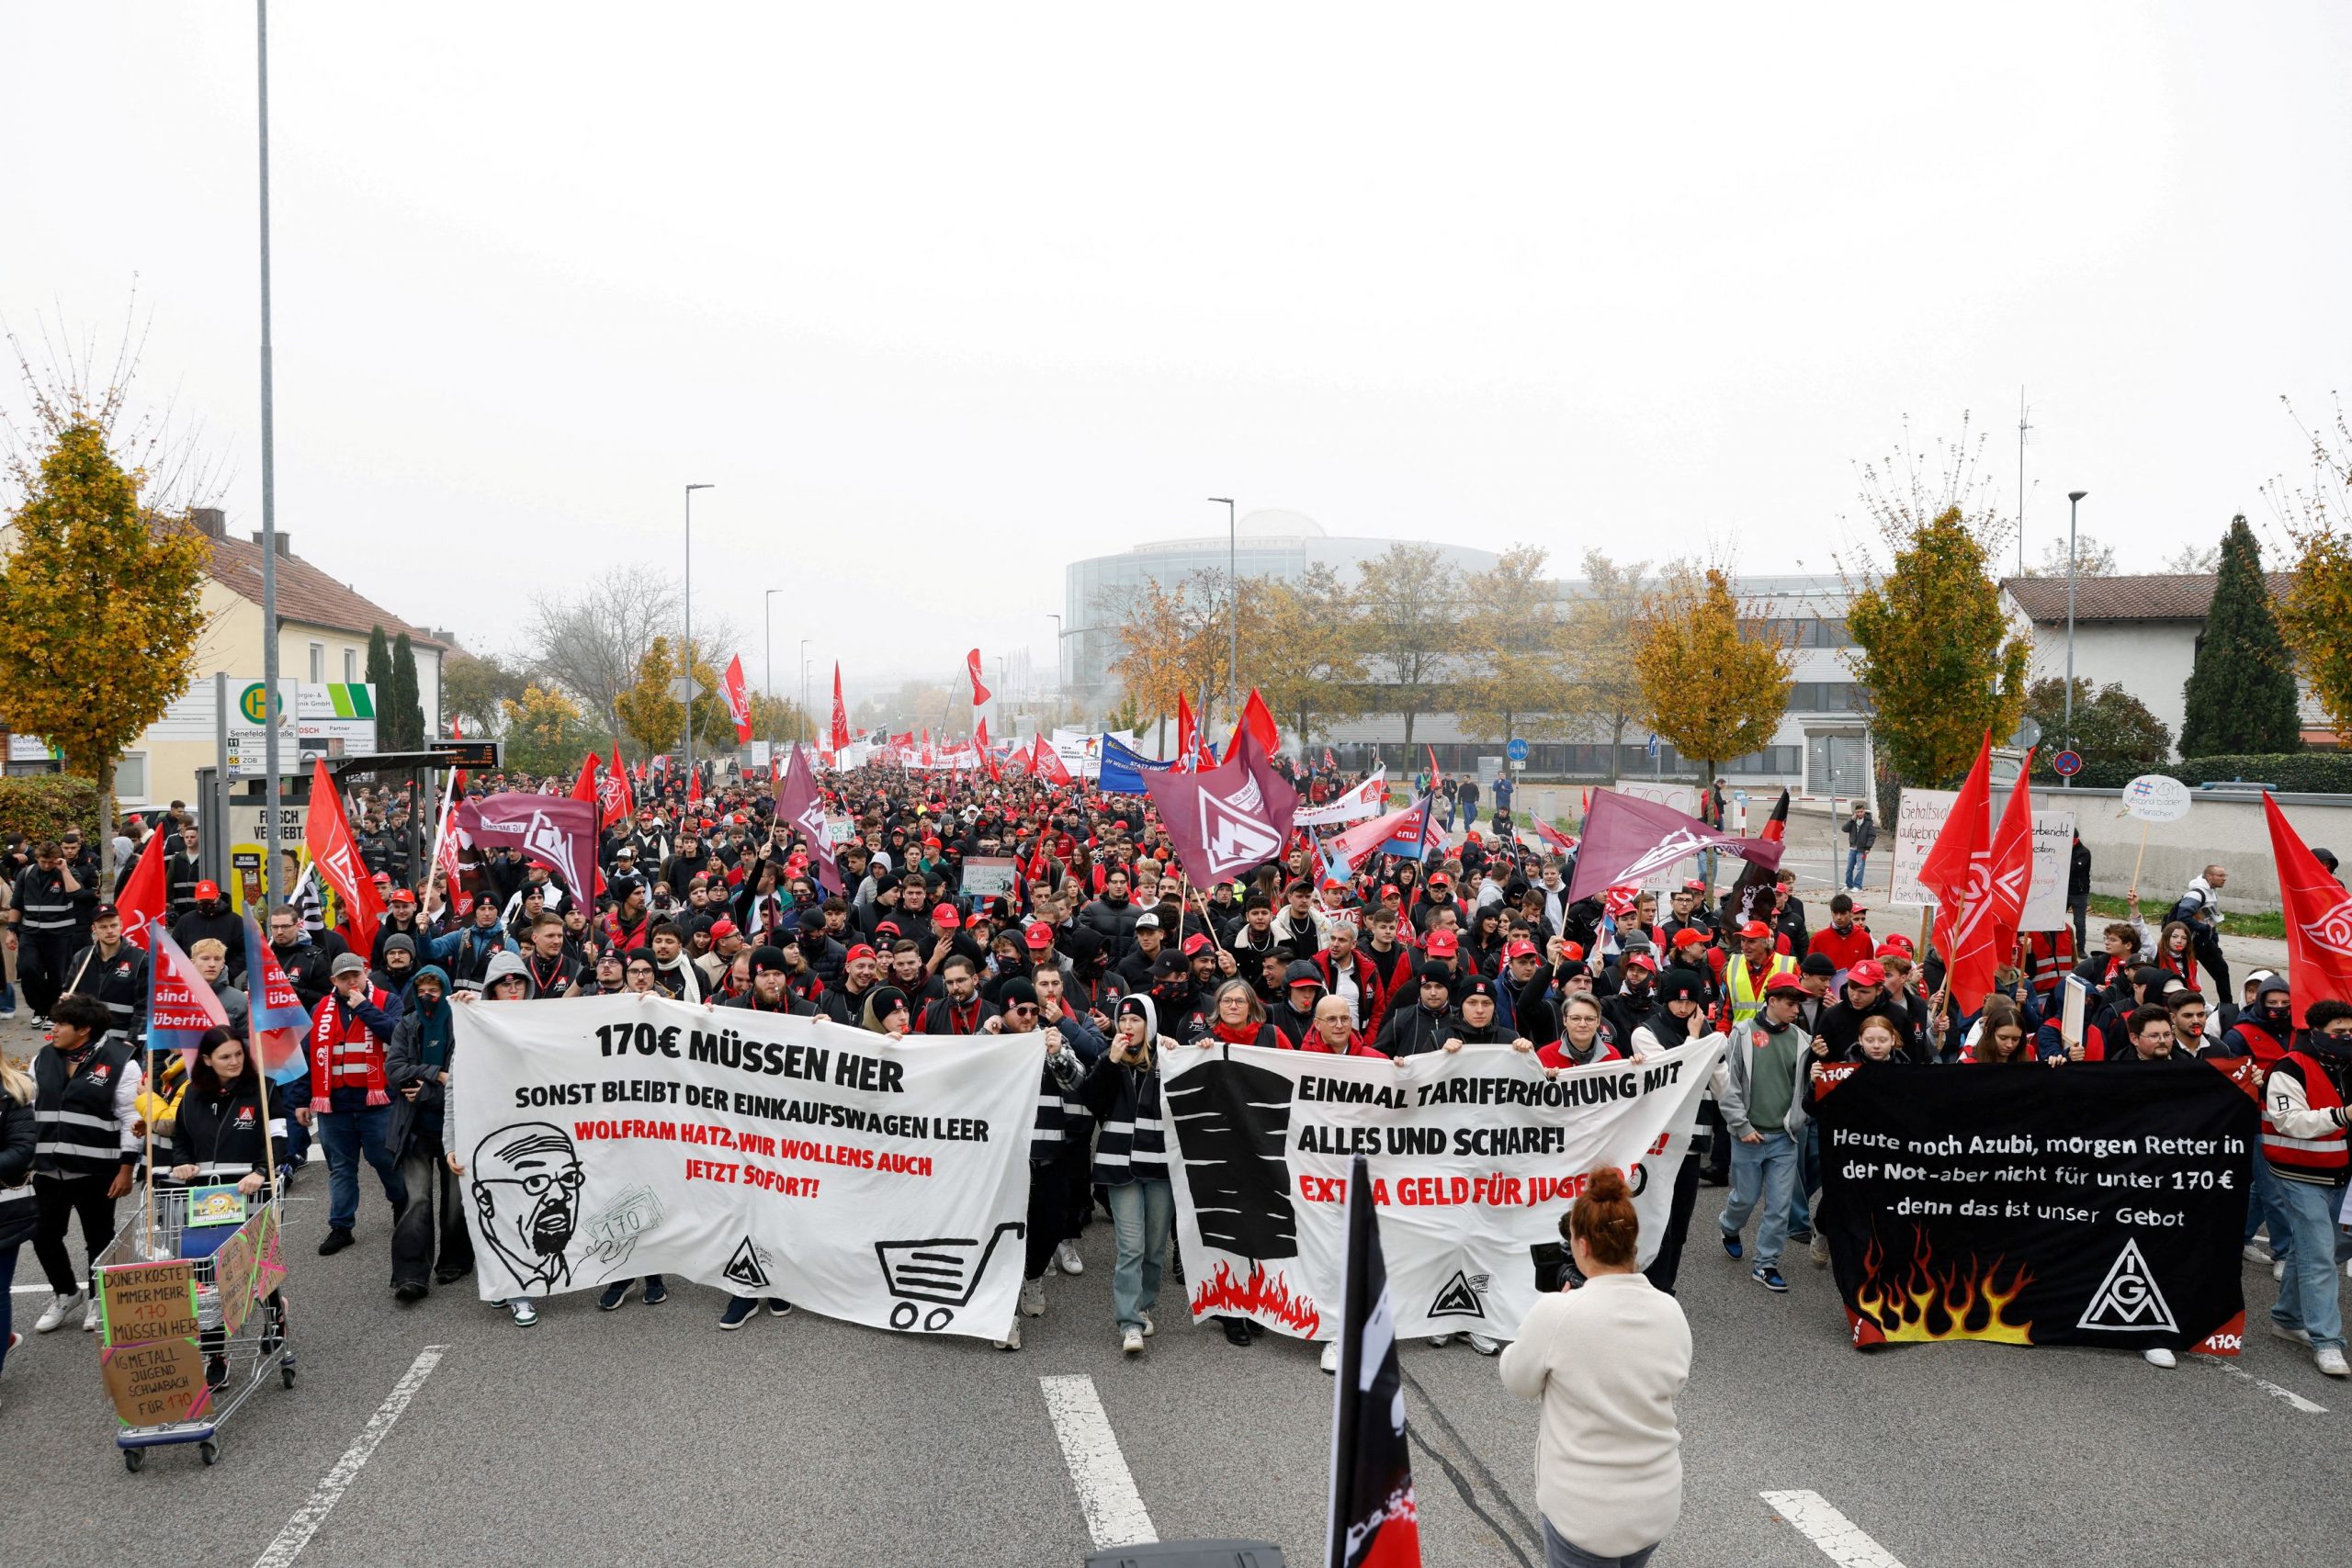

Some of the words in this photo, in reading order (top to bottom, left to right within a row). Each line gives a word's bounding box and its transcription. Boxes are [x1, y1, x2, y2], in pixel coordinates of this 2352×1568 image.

[156, 989, 189, 1002] sind
[318, 1013, 333, 1042] YOU
[595, 1022, 682, 1058] 170€
[689, 1029, 829, 1082] MÜSSEN
[835, 1052, 904, 1093] HER
[1298, 1075, 1408, 1109] EINMAL
[1418, 1073, 1637, 1108] TARIFERHÖHUNG
[1643, 1060, 1683, 1095] MIT
[515, 1083, 596, 1108] SONST
[603, 1080, 681, 1103] BLEIBT
[685, 1084, 729, 1111] DER
[734, 1093, 928, 1139] EINKAUFSWAGEN
[933, 1117, 989, 1142] LEER
[2277, 1095, 2290, 1111] B
[574, 1119, 676, 1141] WOLFRAM
[781, 1138, 874, 1169] WOLLENS
[876, 1152, 933, 1177] AUCH
[1297, 1125, 1381, 1155] ALLES
[1387, 1127, 1447, 1155] UND
[1453, 1126, 1566, 1156] SCHARF!
[1833, 1129, 1900, 1149] Heute
[1908, 1134, 1962, 1156] noch
[1969, 1134, 2039, 1156] Azubi,
[2046, 1136, 2137, 1158] morgen
[2145, 1135, 2218, 1156] Retter
[2224, 1134, 2245, 1154] in
[686, 1159, 740, 1182] JETZT
[743, 1164, 820, 1199] SOFORT!
[1843, 1160, 1879, 1179] der
[1994, 1166, 2046, 1181] nicht
[2054, 1167, 2089, 1186] für
[2097, 1171, 2164, 1189] unter
[1299, 1175, 1391, 1206] EXTA
[1396, 1177, 1469, 1206] GELD
[1472, 1172, 1522, 1206] FÜR
[601, 1211, 639, 1239] 170
[1960, 1199, 1998, 1217] das
[2005, 1200, 2030, 1218] ist
[2037, 1205, 2099, 1224] unser
[2116, 1207, 2185, 1227] Gebot
[103, 1270, 142, 1288] DÖNER
[145, 1266, 194, 1284] KOSTET
[118, 1290, 150, 1305] IMMER
[135, 1303, 167, 1320] 170
[114, 1321, 168, 1341] MÜSSEN
[171, 1318, 198, 1336] HER
[2205, 1334, 2243, 1350] 170€
[129, 1377, 189, 1397] SCHWABACH
[131, 1365, 176, 1382] JUGEND
[139, 1400, 165, 1416] FÜR
[167, 1393, 193, 1410] 170
